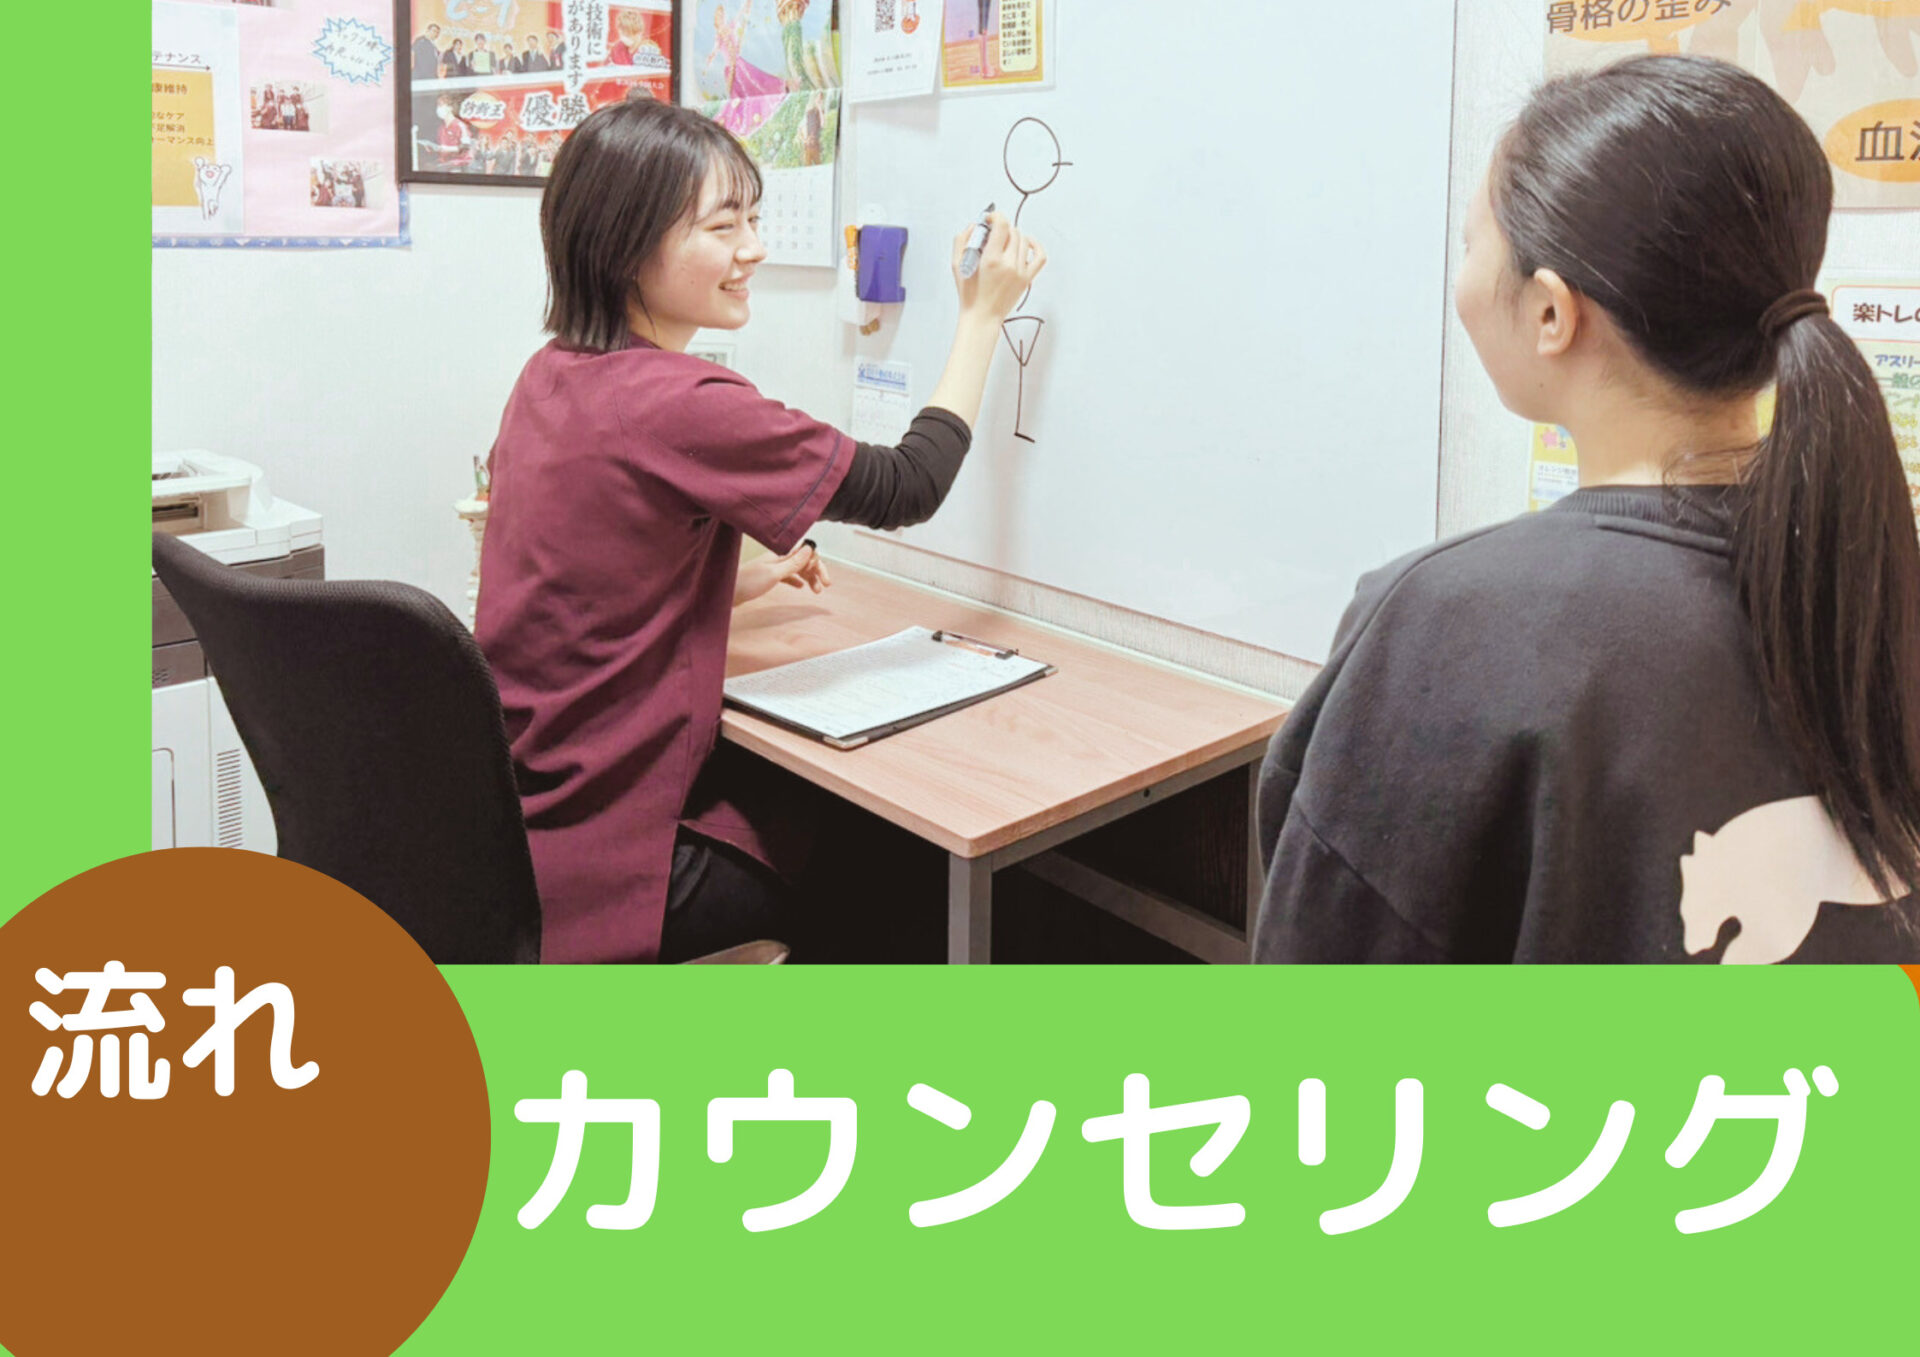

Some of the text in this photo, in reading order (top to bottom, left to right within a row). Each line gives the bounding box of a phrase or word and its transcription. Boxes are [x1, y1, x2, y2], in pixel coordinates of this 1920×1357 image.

[152, 136, 213, 146] ーマンス向上
